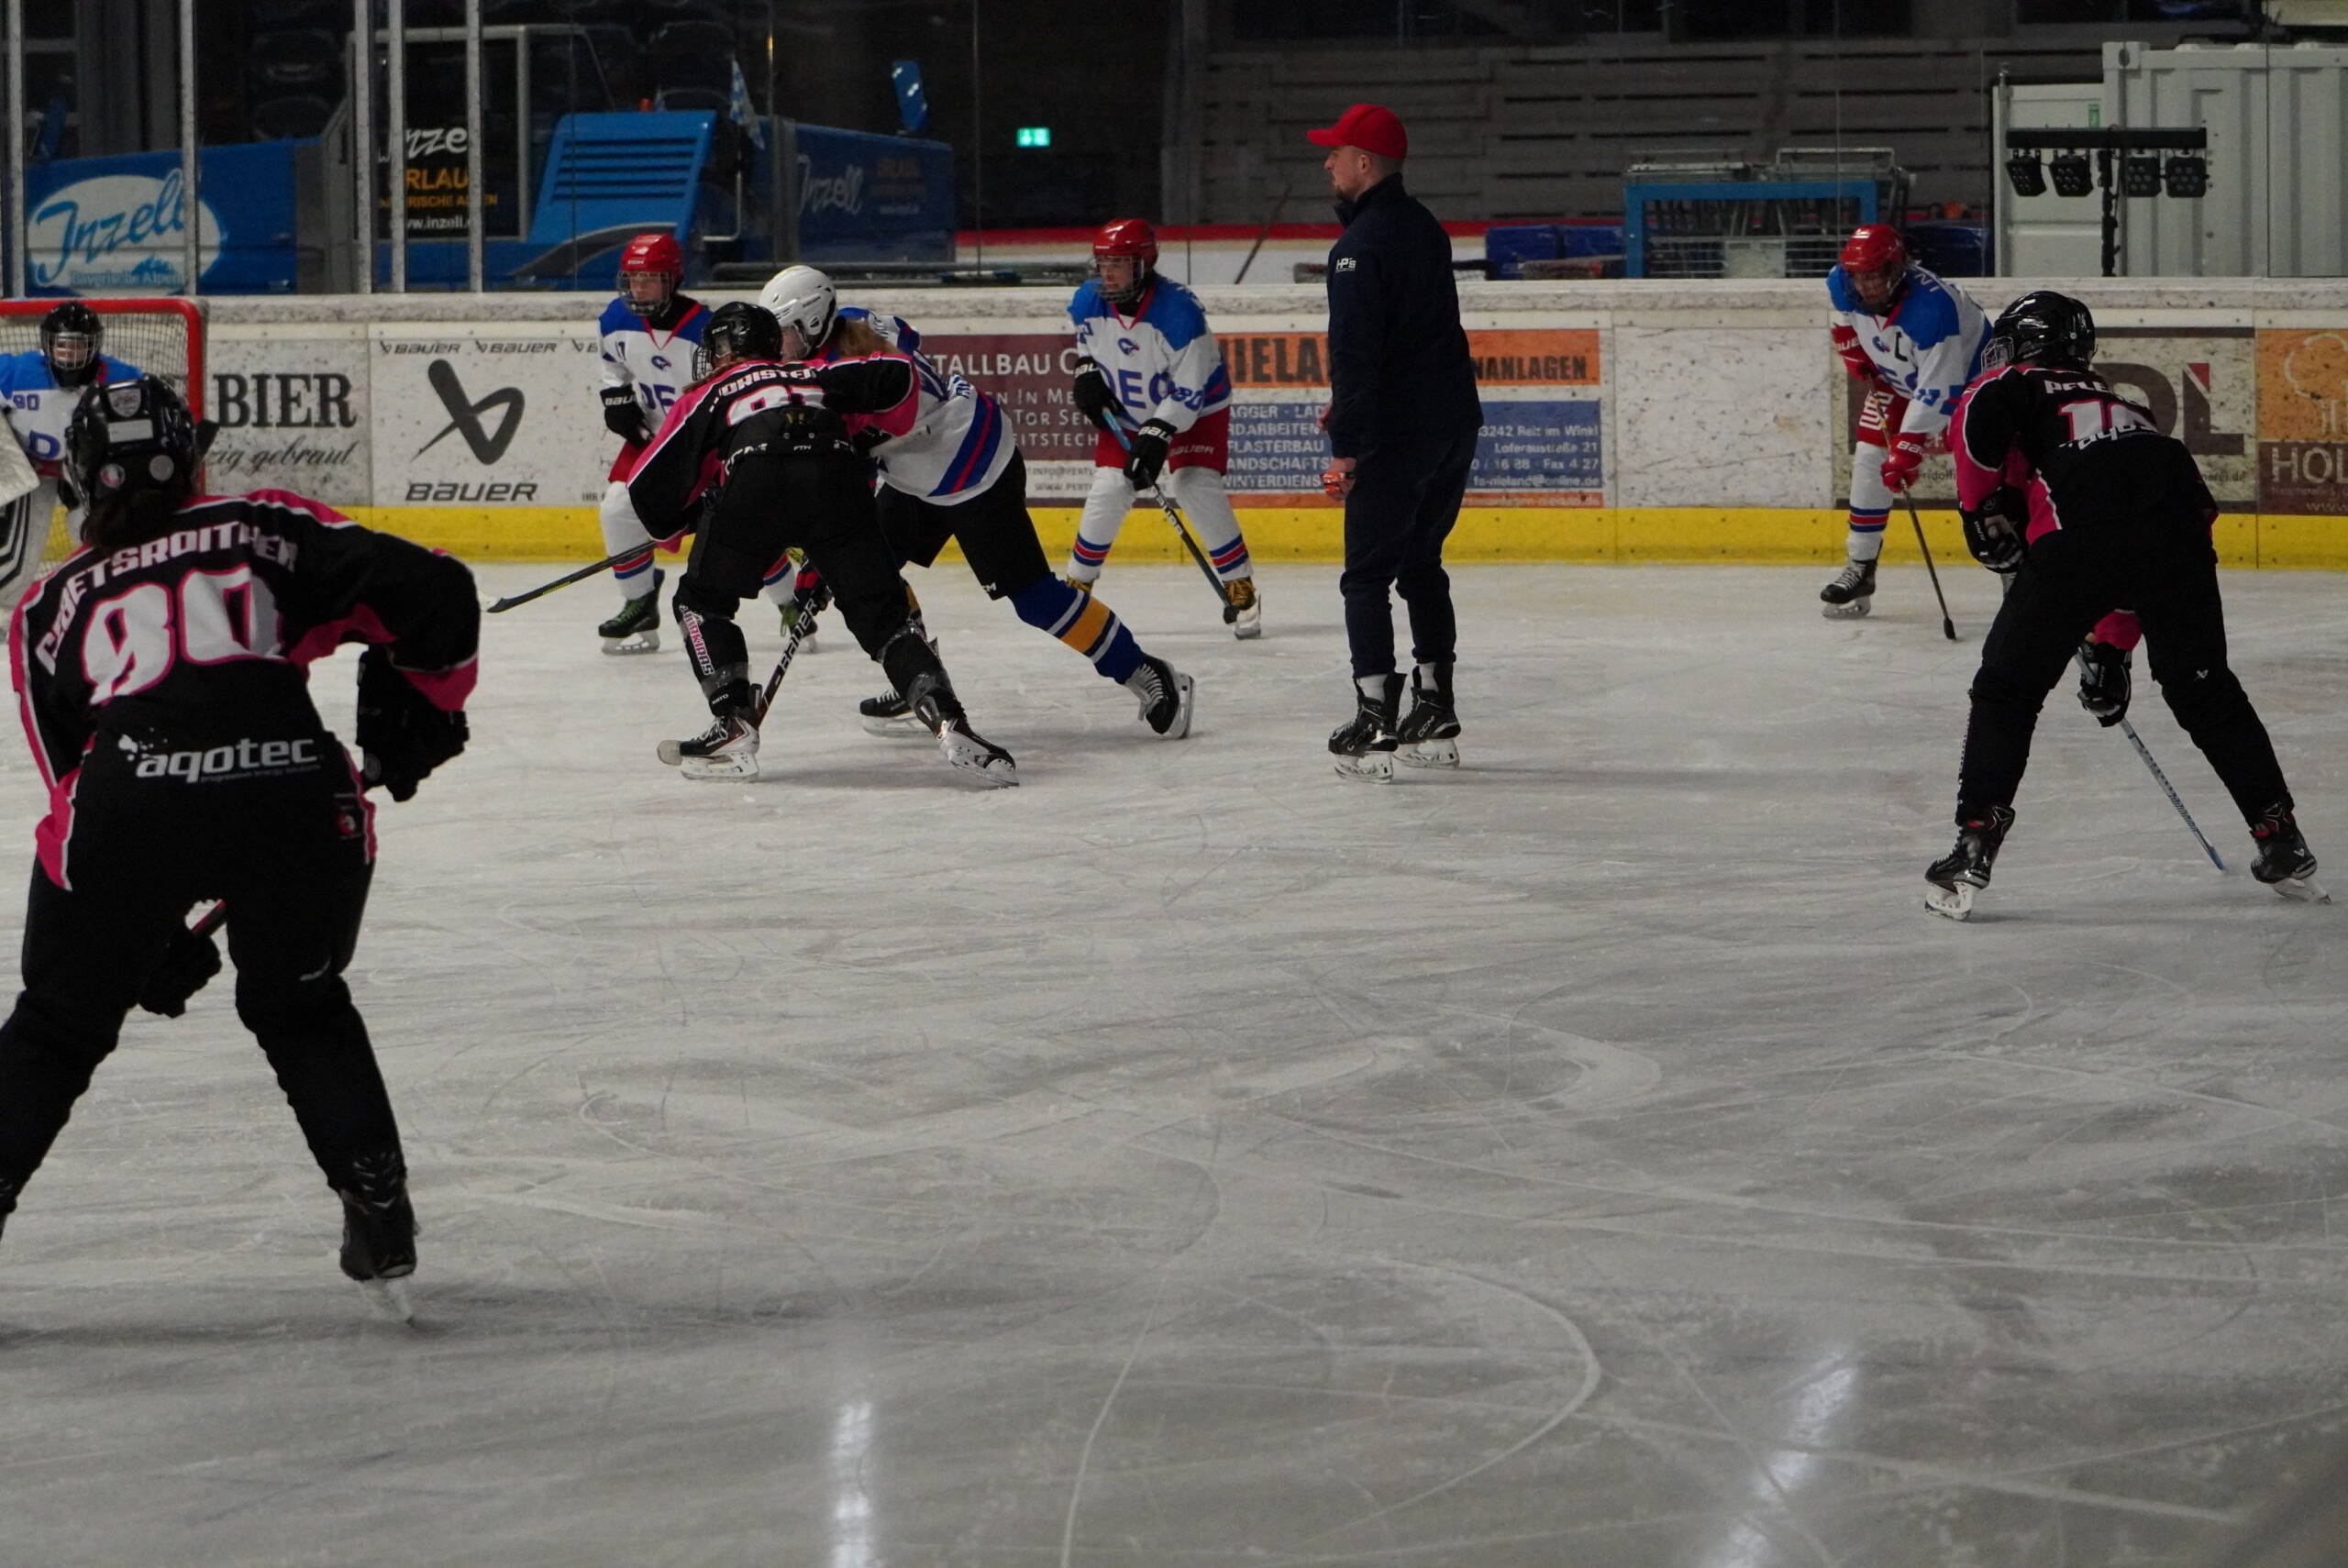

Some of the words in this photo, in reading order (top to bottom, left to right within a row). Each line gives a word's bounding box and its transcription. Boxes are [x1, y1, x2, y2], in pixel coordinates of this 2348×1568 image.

[405, 127, 468, 159] nze
[406, 167, 470, 190] RLAU
[394, 343, 461, 354] BAUER
[490, 342, 558, 353] BAUER
[926, 353, 1051, 376] TALLBAU
[1219, 337, 1329, 383] IELA
[1471, 356, 1586, 380] NANLAGEN
[212, 373, 358, 428] BIER
[1230, 405, 1278, 419] AGGER
[1013, 433, 1099, 447] EITSTECH
[1227, 440, 1324, 453] FLASTERBAU
[1226, 458, 1330, 470] ANDSCHAFTS
[1544, 458, 1565, 469] Fax
[2271, 447, 2348, 483] HOL
[1222, 475, 1322, 488] INTERDIENS
[405, 482, 538, 502] BAUER
[135, 737, 318, 784] aqotec
